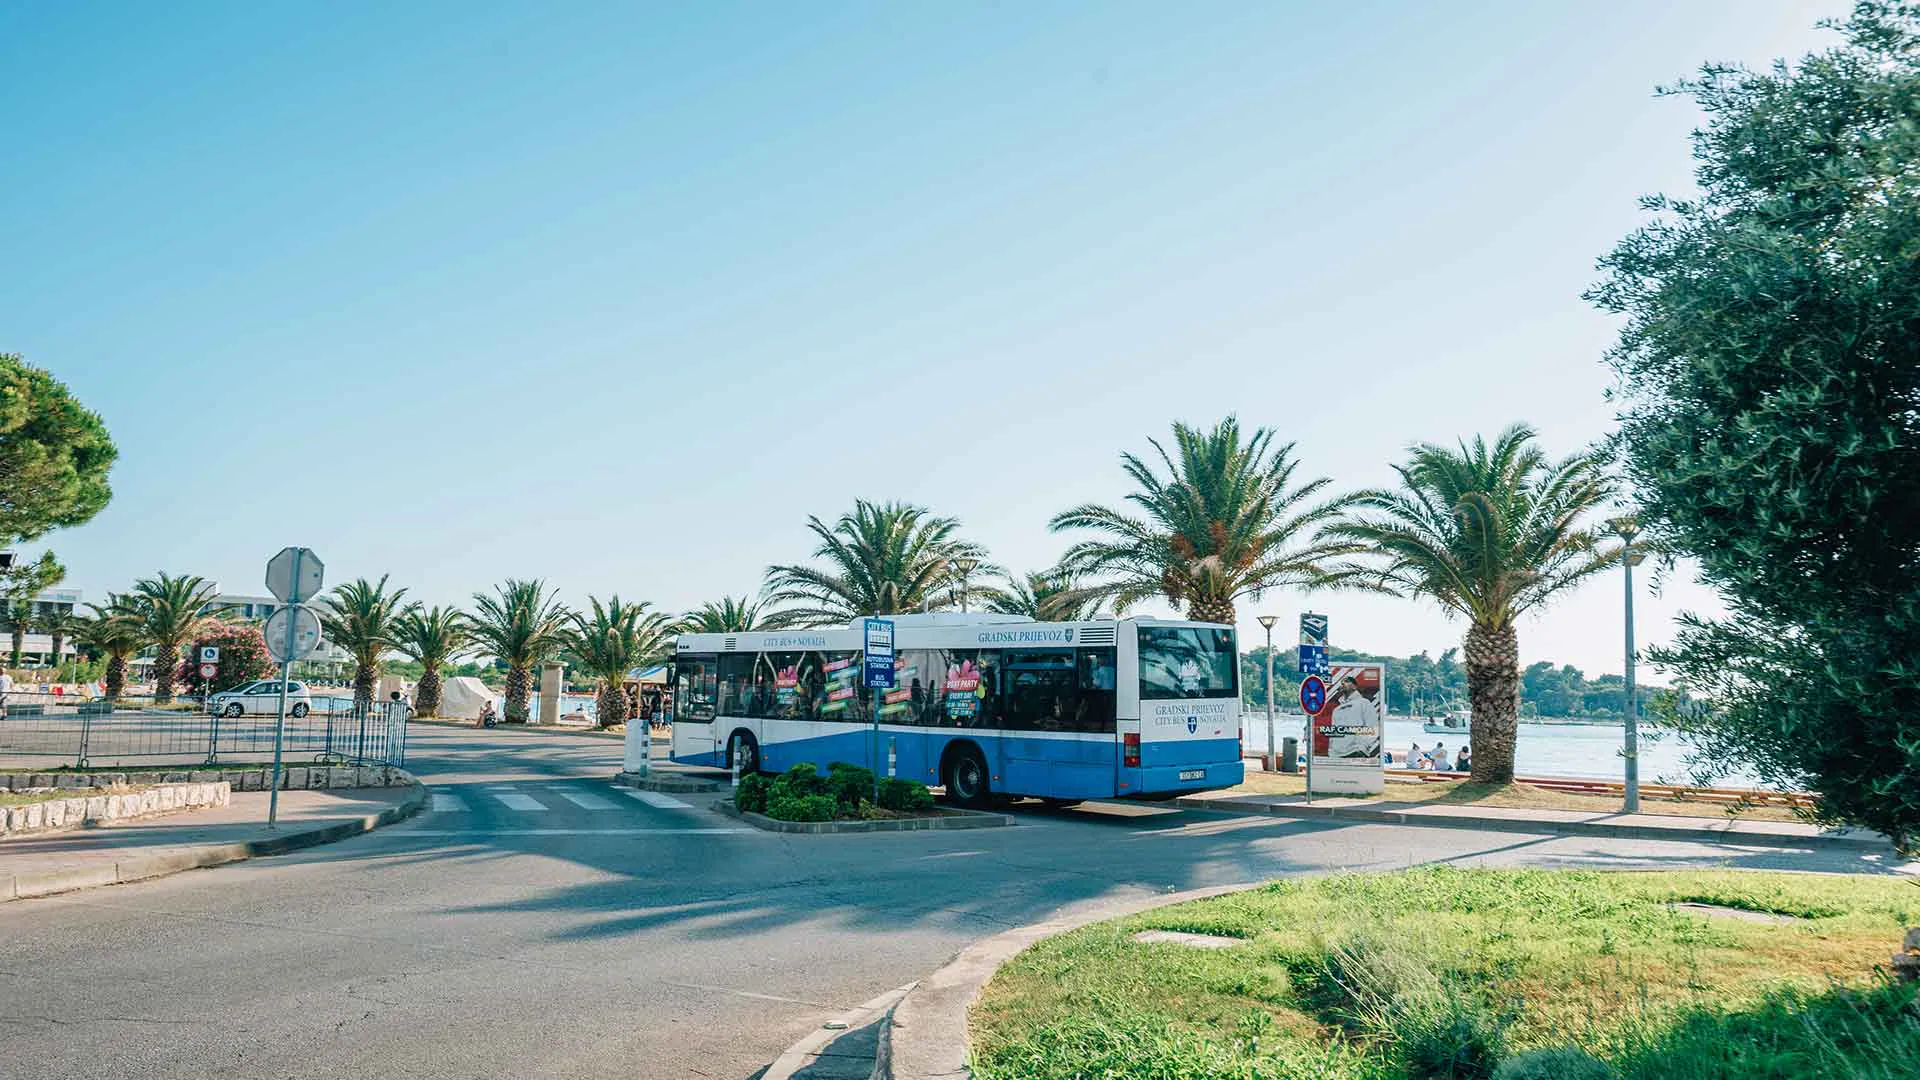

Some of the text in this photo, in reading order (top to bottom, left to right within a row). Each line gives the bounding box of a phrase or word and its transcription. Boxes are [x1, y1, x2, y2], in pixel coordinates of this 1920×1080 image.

[868, 622, 892, 632] CITY BUS
[978, 631, 1017, 642] GRADSKI
[960, 679, 978, 688] PARTY
[1155, 705, 1189, 715] GRADSKI
[1155, 717, 1172, 725] CITY
